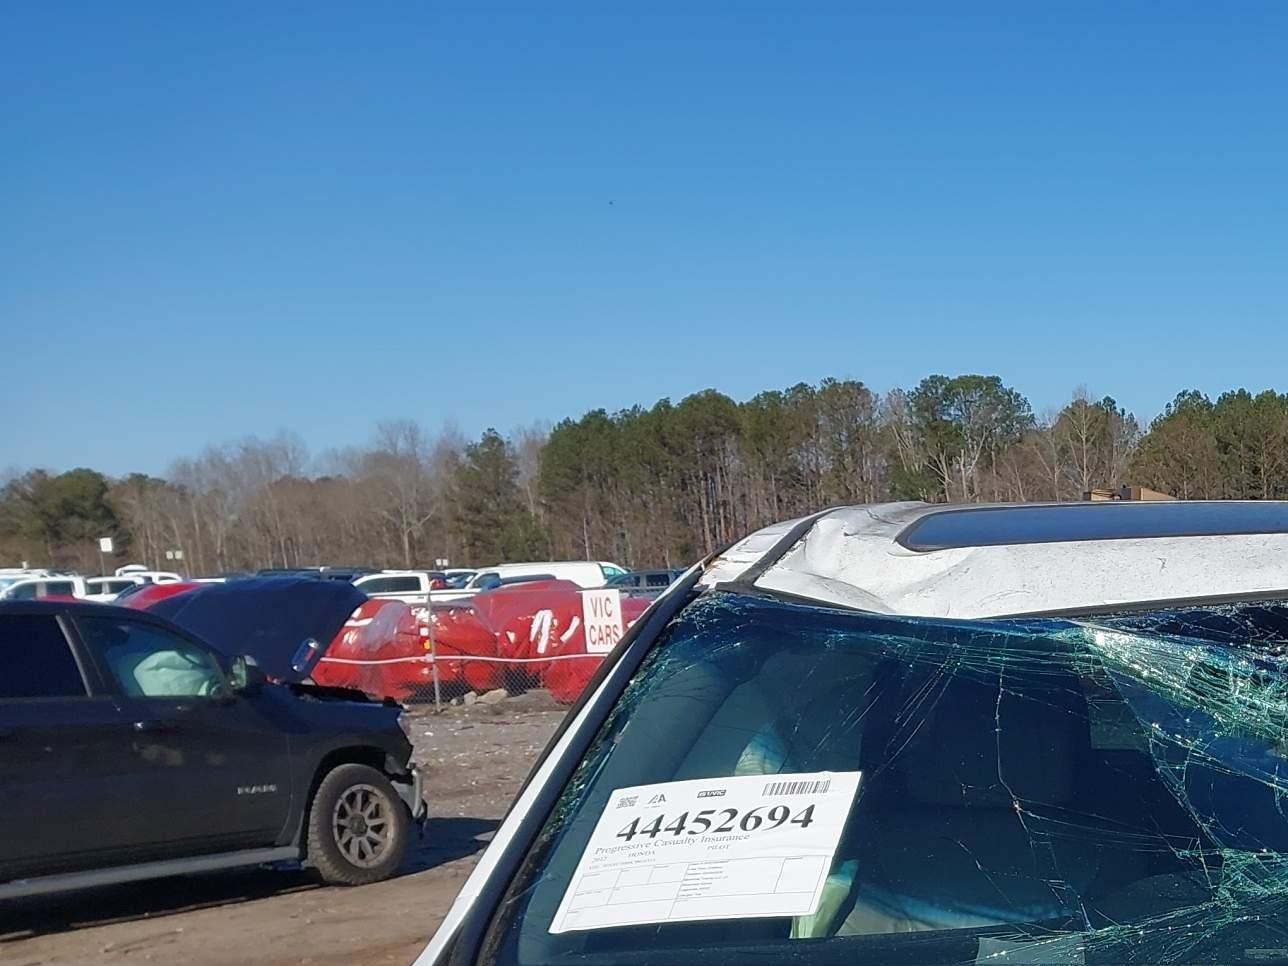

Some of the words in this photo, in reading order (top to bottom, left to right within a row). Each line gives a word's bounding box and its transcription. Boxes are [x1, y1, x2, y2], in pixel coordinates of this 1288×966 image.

[590, 596, 613, 618] VIC
[589, 623, 620, 646] CARS
[616, 803, 816, 842] 44452694
[594, 842, 652, 855] Progressive
[653, 836, 698, 848] Casualty
[700, 834, 751, 843] Insurance
